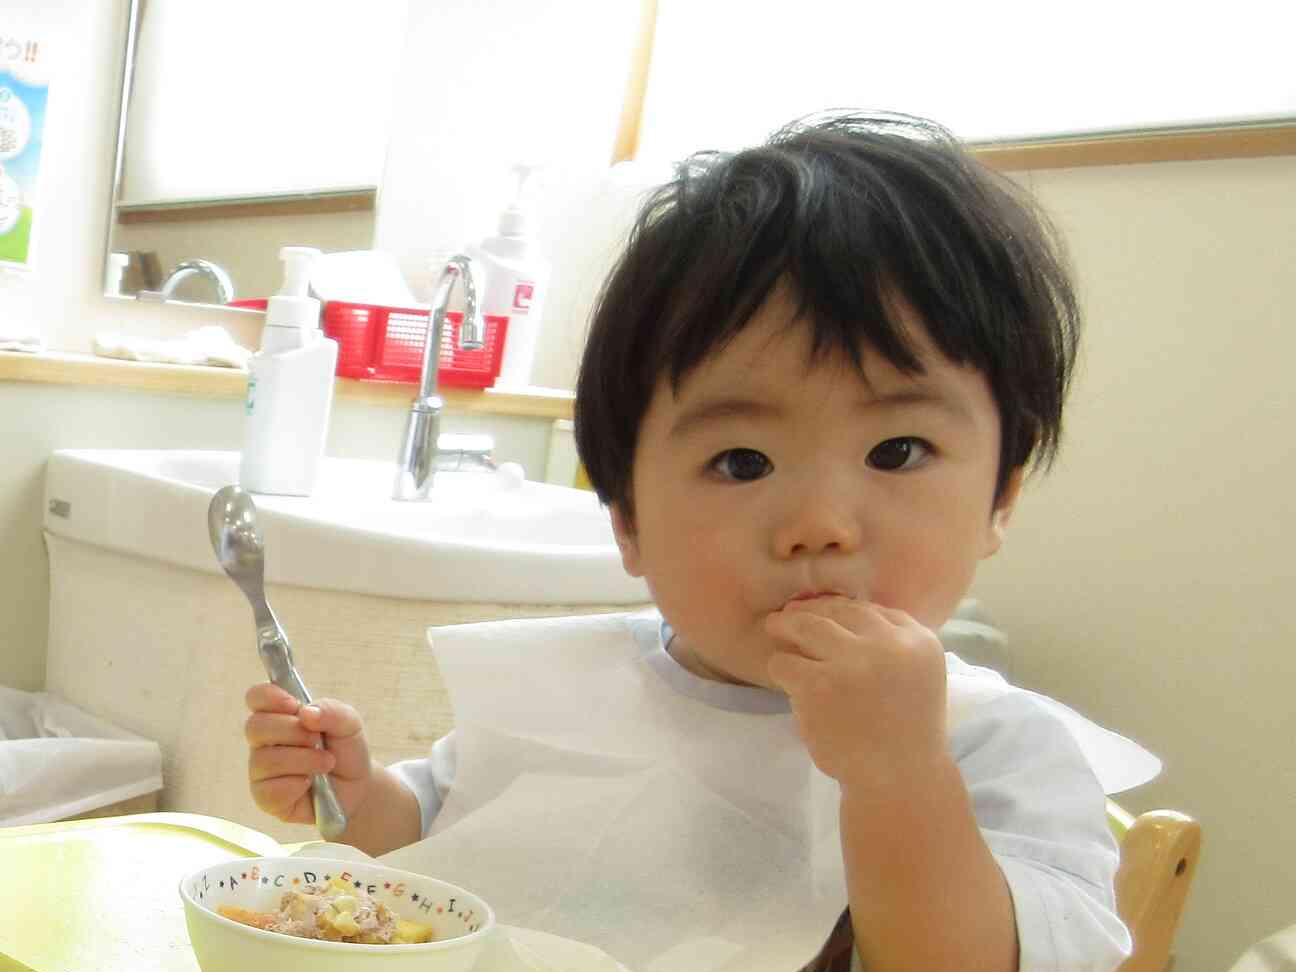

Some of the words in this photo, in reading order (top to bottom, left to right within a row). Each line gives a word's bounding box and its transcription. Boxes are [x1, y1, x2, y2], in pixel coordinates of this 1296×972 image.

[274, 874, 285, 887] C
[303, 871, 317, 884] D
[418, 898, 433, 914] H
[448, 898, 456, 912] I
